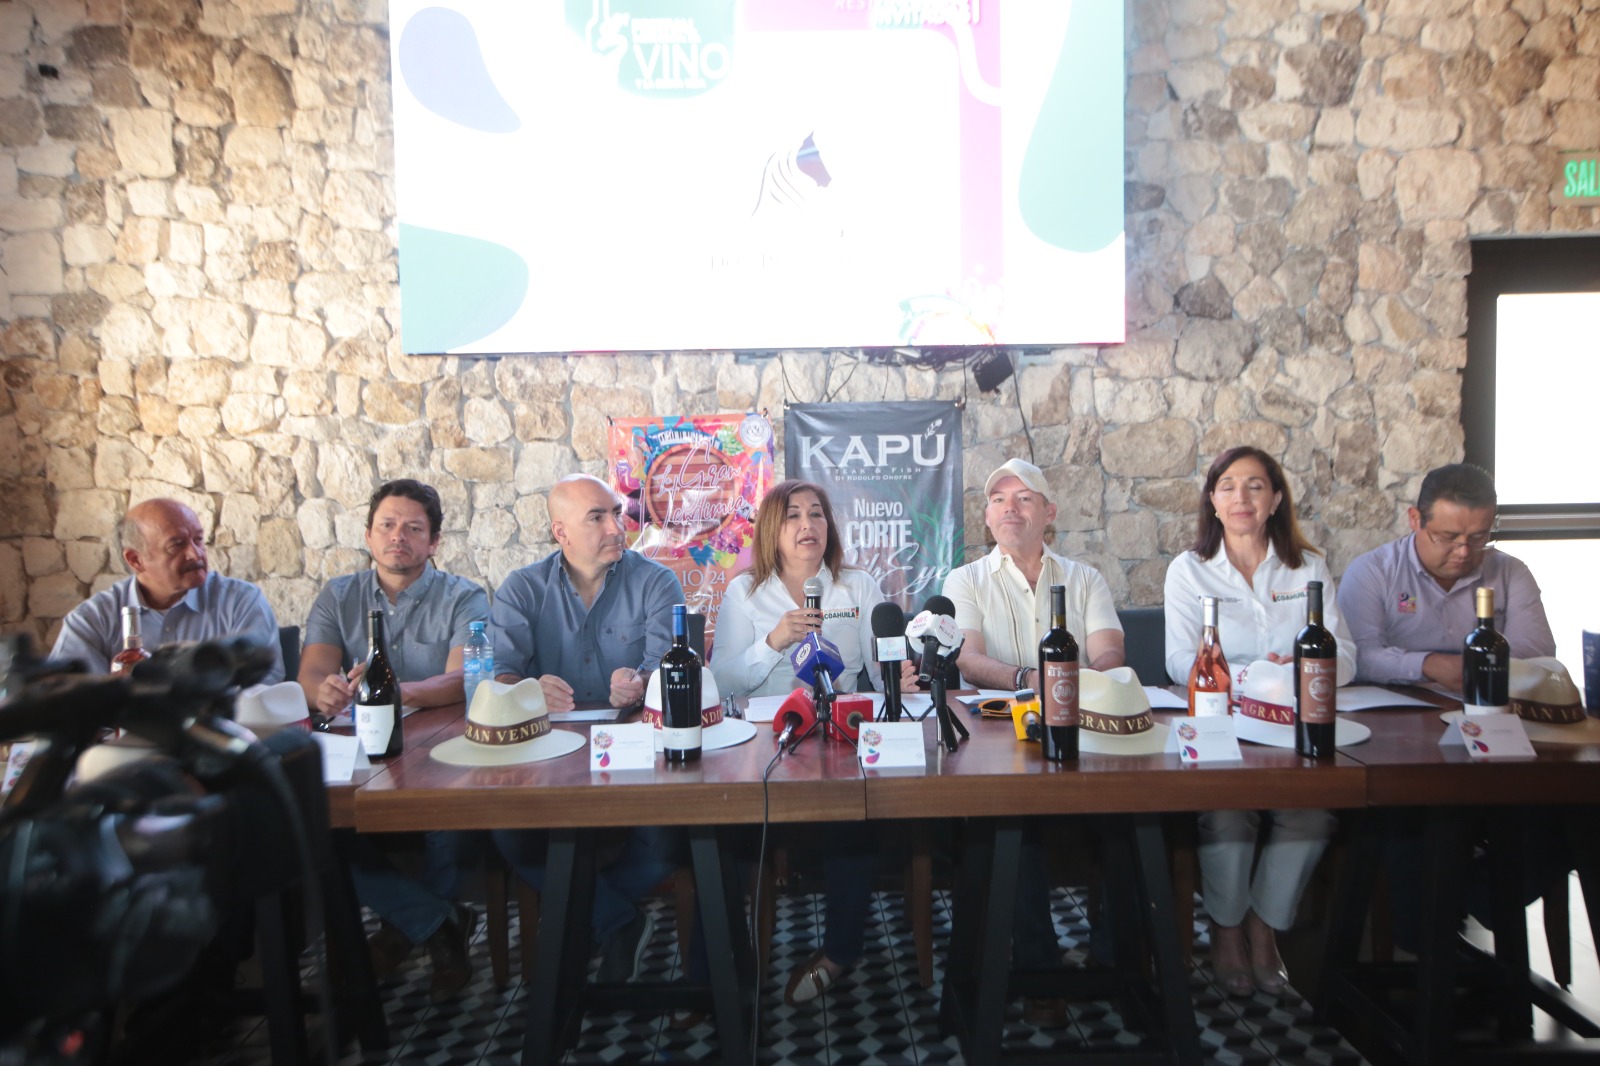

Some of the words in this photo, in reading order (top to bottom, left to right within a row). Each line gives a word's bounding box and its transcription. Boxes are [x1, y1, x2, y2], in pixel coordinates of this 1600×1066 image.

[632, 42, 730, 80] VINO
[1563, 159, 1600, 198] SAL
[855, 498, 903, 518] Nuevo
[847, 519, 912, 549] CORTE
[709, 570, 726, 585] 24
[1079, 713, 1119, 732] GRAN
[1126, 711, 1154, 732] VEN
[1249, 706, 1292, 723] GRAN
